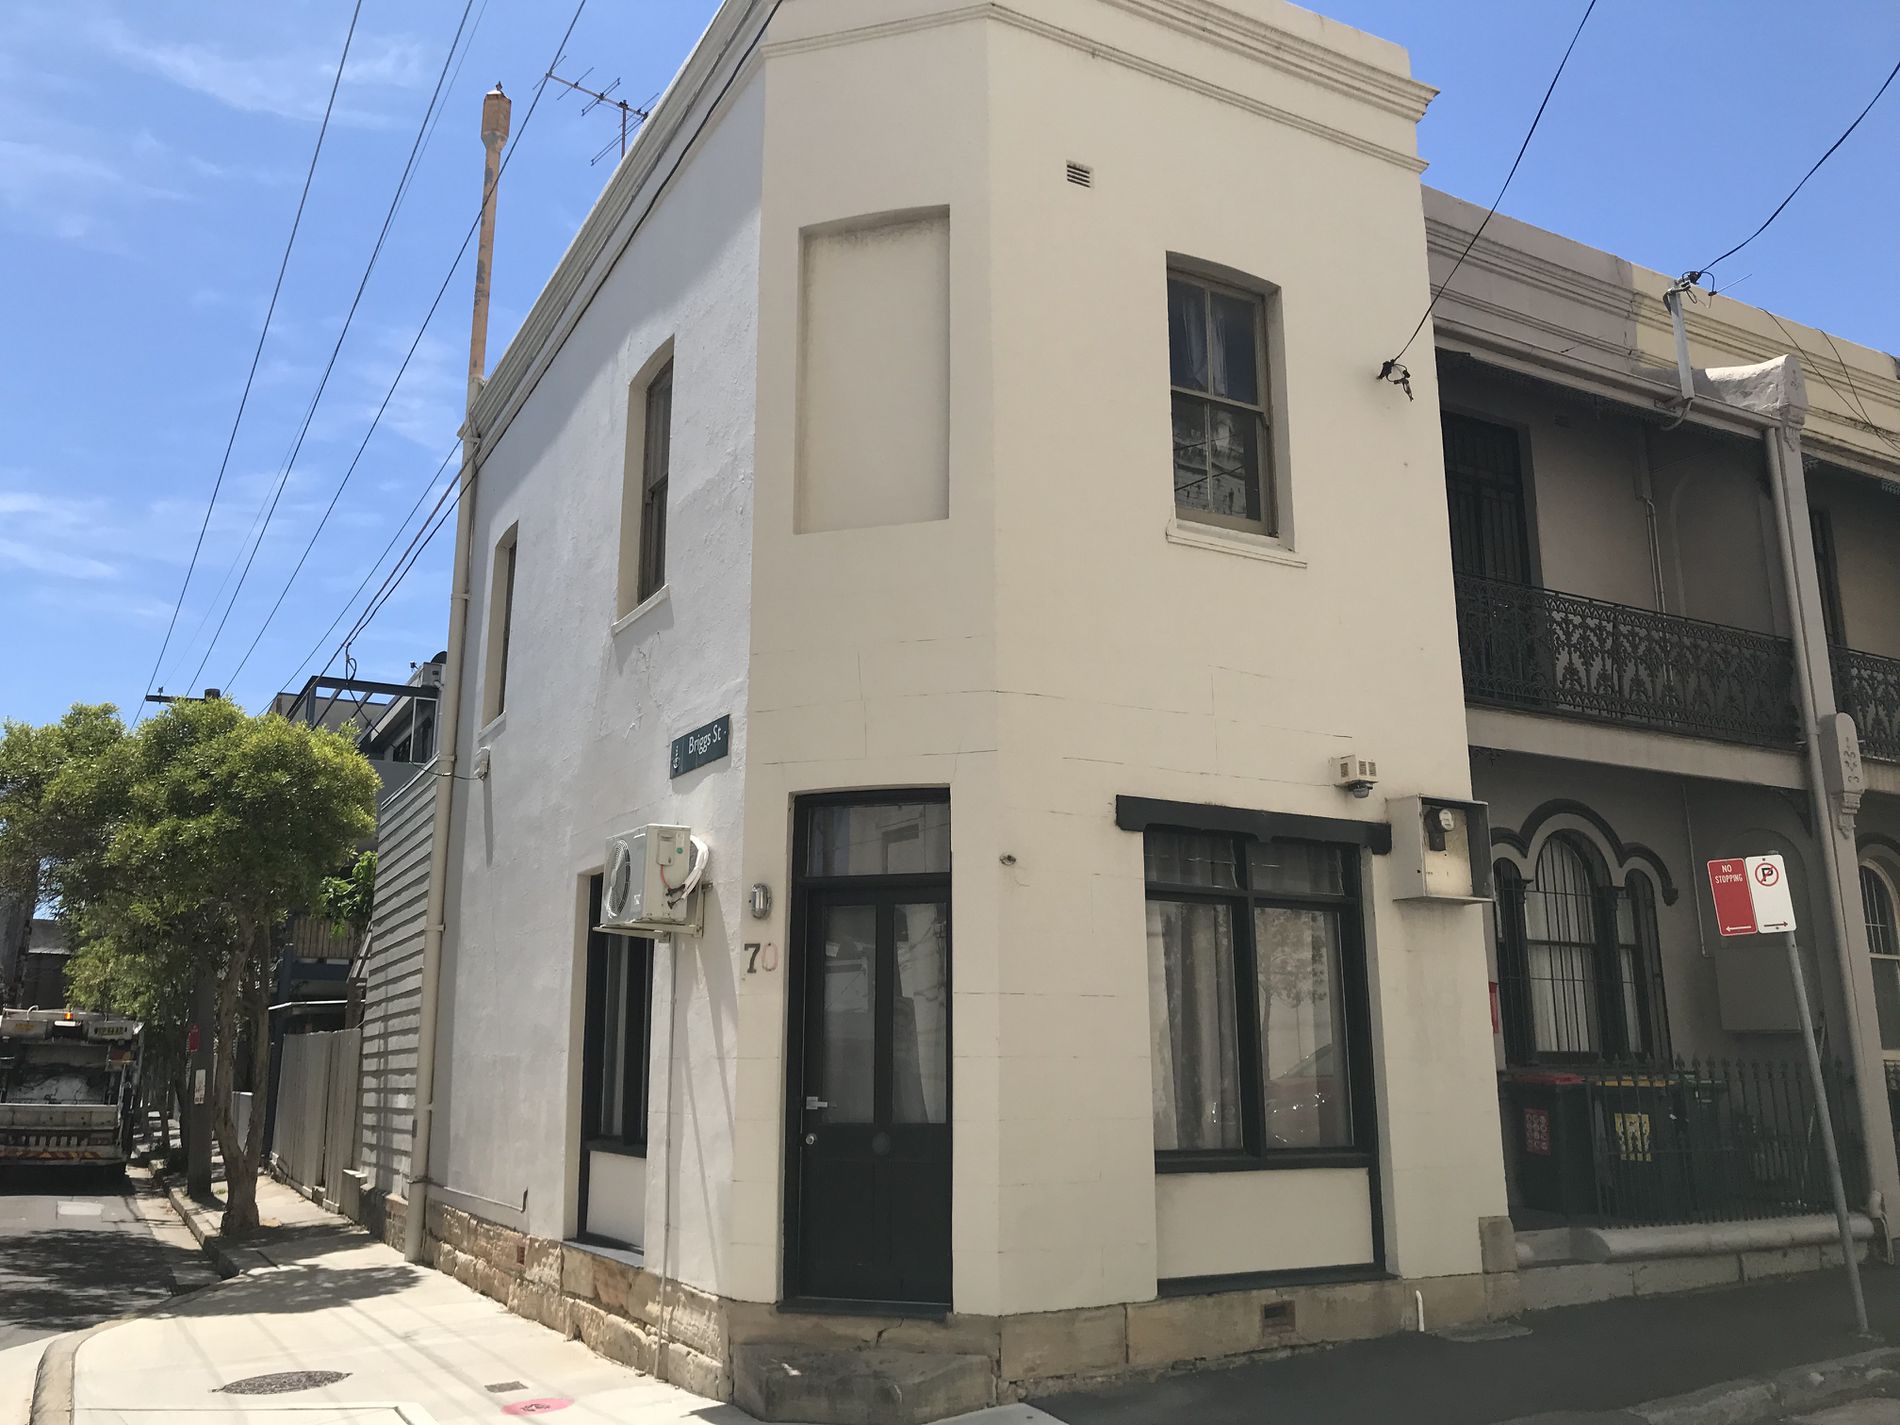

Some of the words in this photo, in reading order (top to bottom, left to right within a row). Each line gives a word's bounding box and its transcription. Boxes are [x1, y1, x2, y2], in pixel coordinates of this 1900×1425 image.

[688, 733, 712, 755] Briggs
[712, 724, 722, 743] St
[1721, 864, 1733, 873] NO
[1761, 867, 1774, 882] P
[1714, 873, 1744, 884] STOPPING
[744, 942, 779, 974] 70
